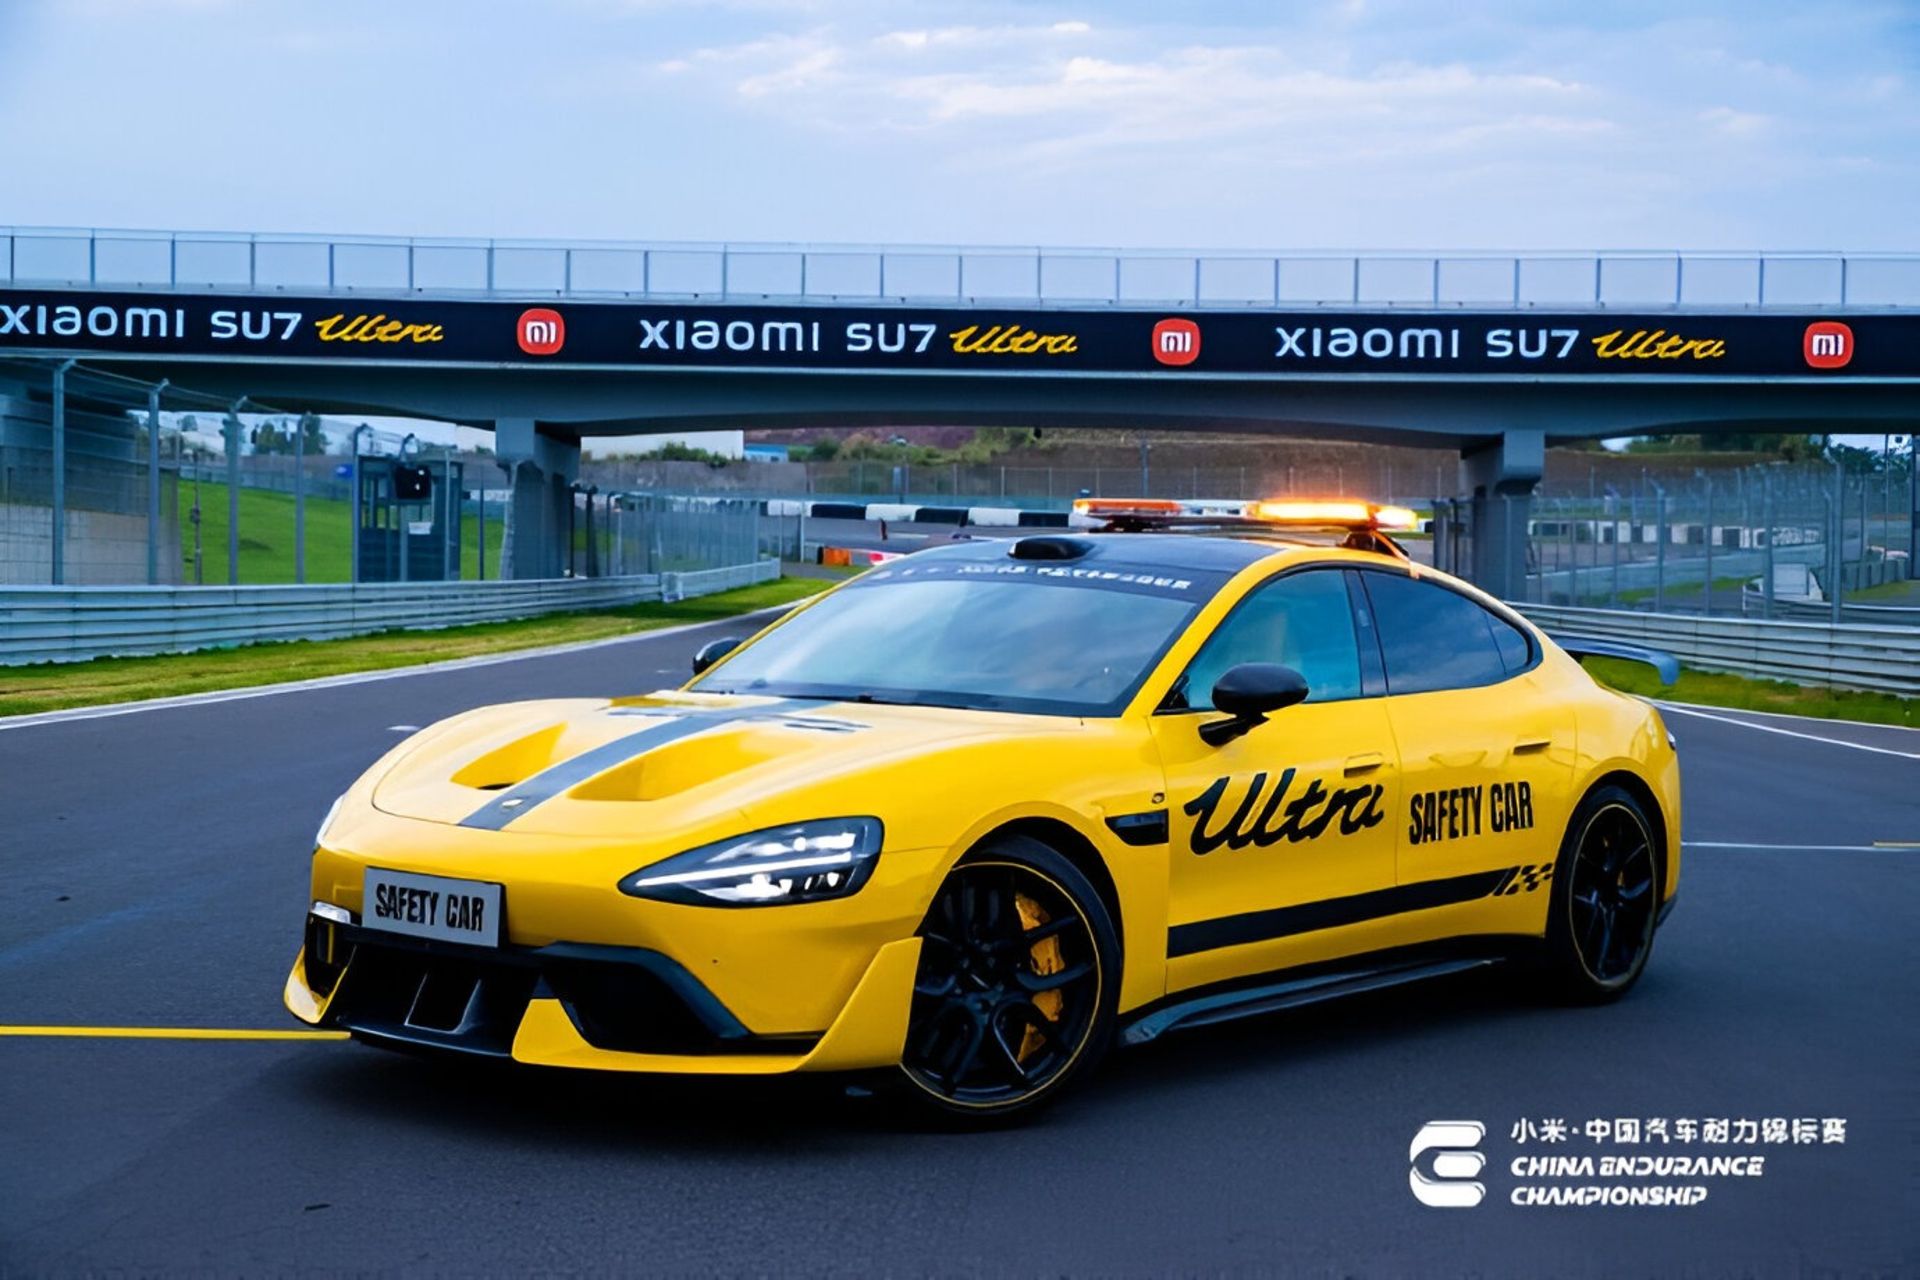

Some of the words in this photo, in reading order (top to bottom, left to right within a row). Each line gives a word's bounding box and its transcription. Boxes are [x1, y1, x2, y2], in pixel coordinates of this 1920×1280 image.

[210, 310, 303, 340] SU7
[846, 322, 937, 353] SU7
[1486, 329, 1580, 358] SU7
[1184, 767, 1384, 856] Ultra
[1408, 787, 1483, 845] SAFETY
[1490, 781, 1534, 831] CAR
[375, 882, 440, 926] SAFETY
[446, 894, 485, 931] CAR
